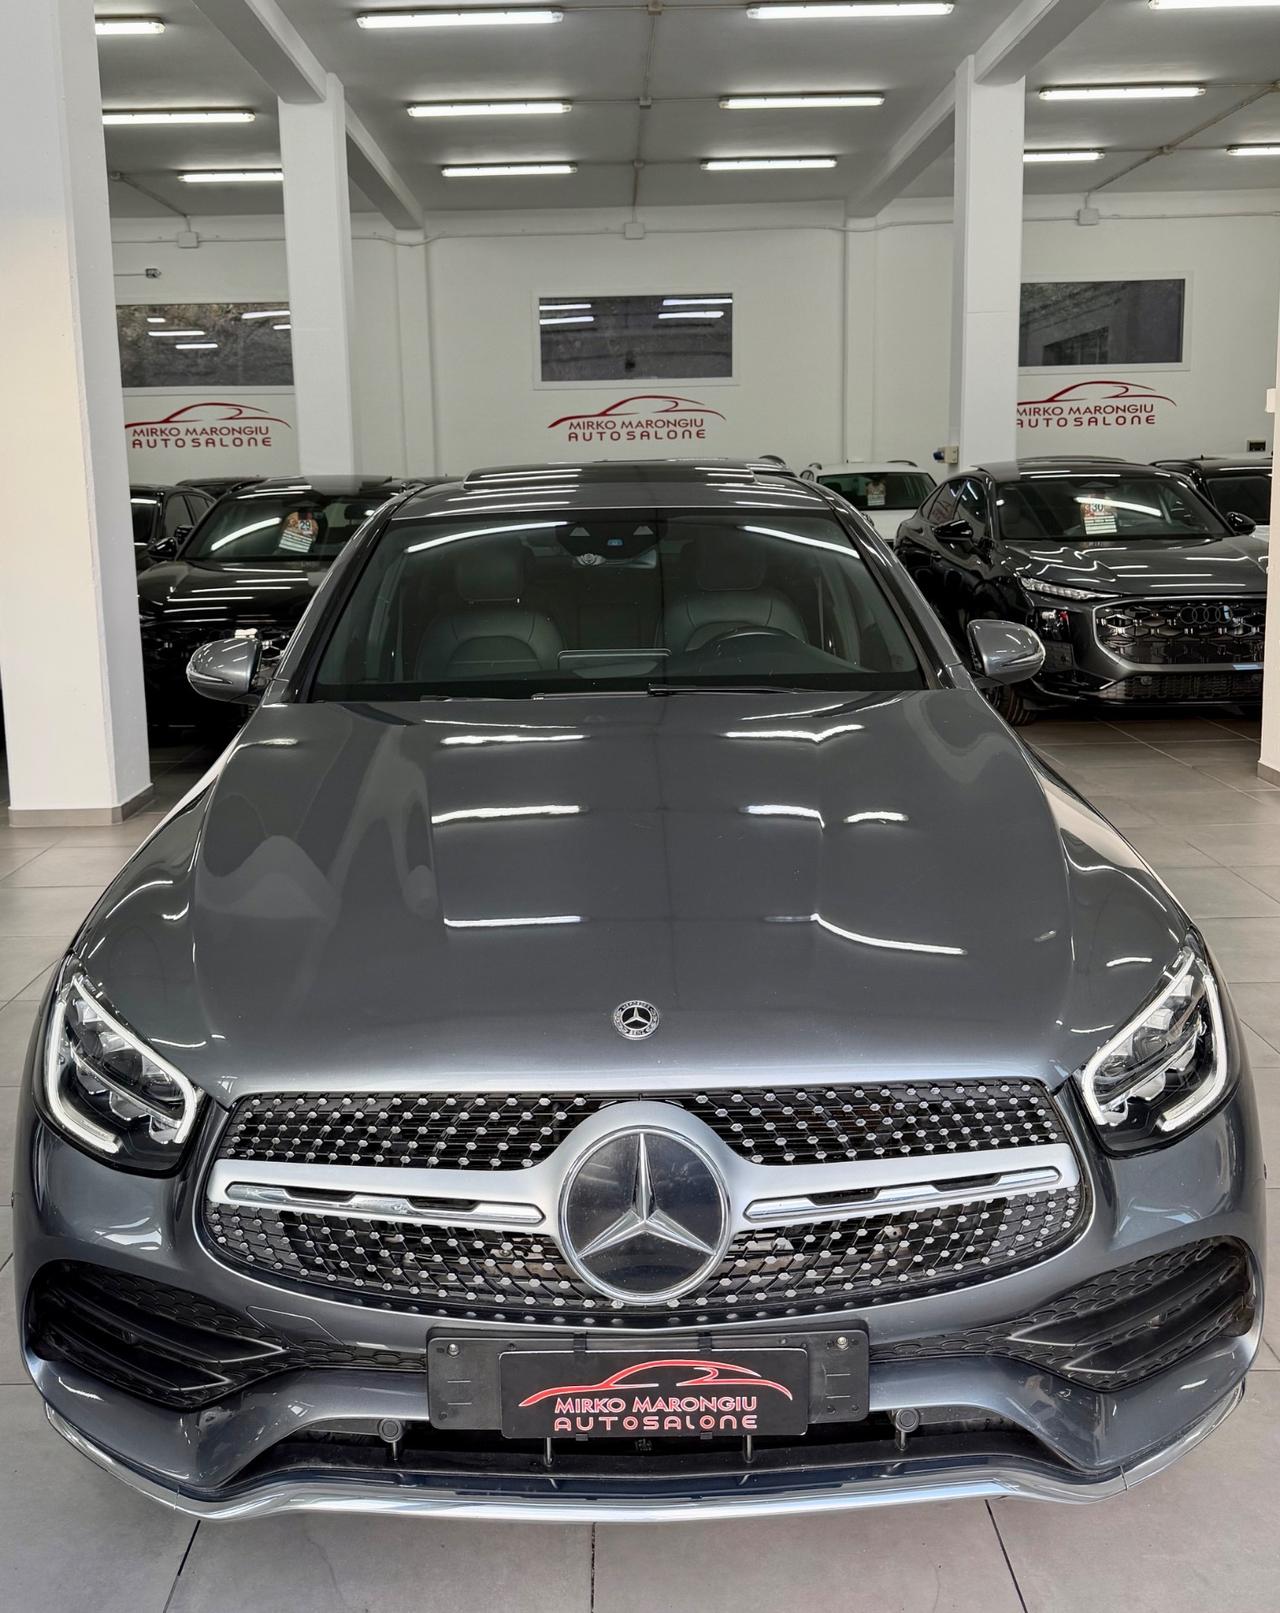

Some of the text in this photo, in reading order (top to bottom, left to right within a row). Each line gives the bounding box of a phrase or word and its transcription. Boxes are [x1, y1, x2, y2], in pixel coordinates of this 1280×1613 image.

[1017, 404, 1154, 417] MIRKO MARONGIU
[568, 418, 704, 430] MIRKO MARONGIU
[132, 426, 270, 437] MIRKO MARONGIU
[568, 429, 706, 442] AUTOSALONE
[132, 437, 272, 449] AUTOSALONE
[554, 1396, 758, 1414] MIRKO MARONGIU
[554, 1415, 758, 1431] AUTOSALONE
